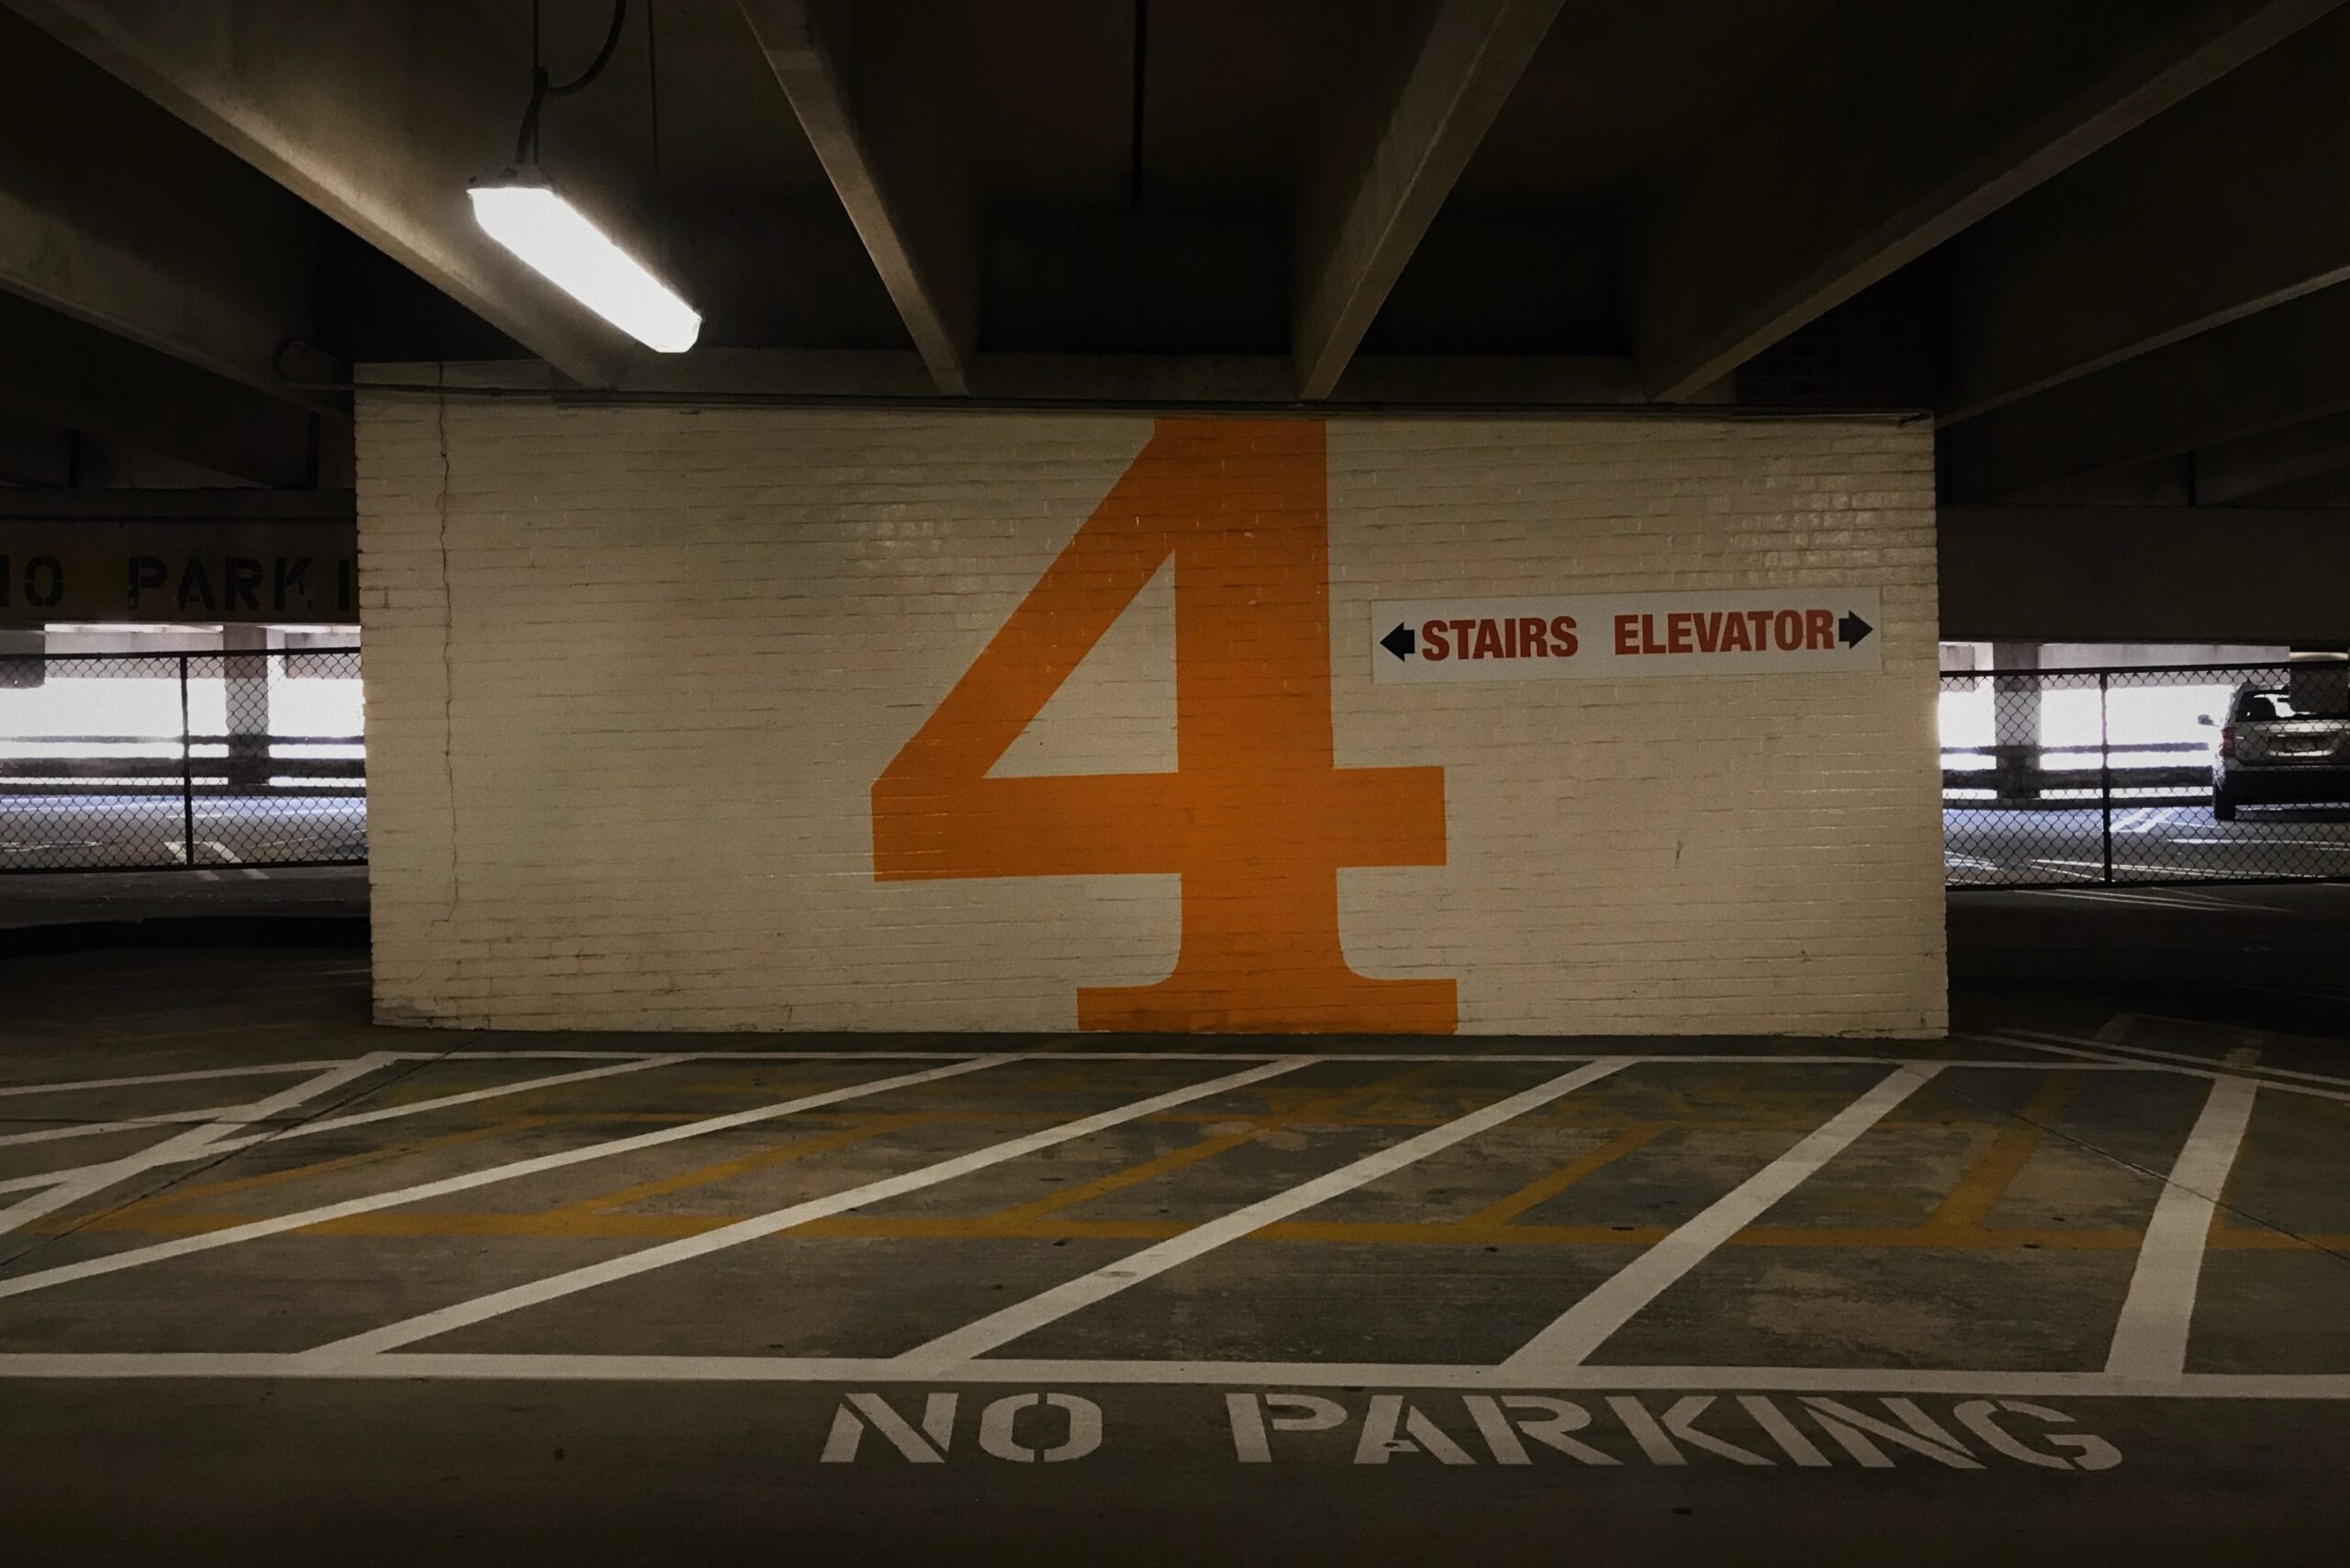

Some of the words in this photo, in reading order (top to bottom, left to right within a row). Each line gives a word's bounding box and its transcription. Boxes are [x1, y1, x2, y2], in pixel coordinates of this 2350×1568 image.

[1422, 616, 1579, 661] STAIRS
[1614, 610, 1835, 655] ELEVATOR
[871, 418, 1458, 1035] 4
[819, 1392, 1102, 1463] NO
[1225, 1393, 2122, 1470] PARKING
